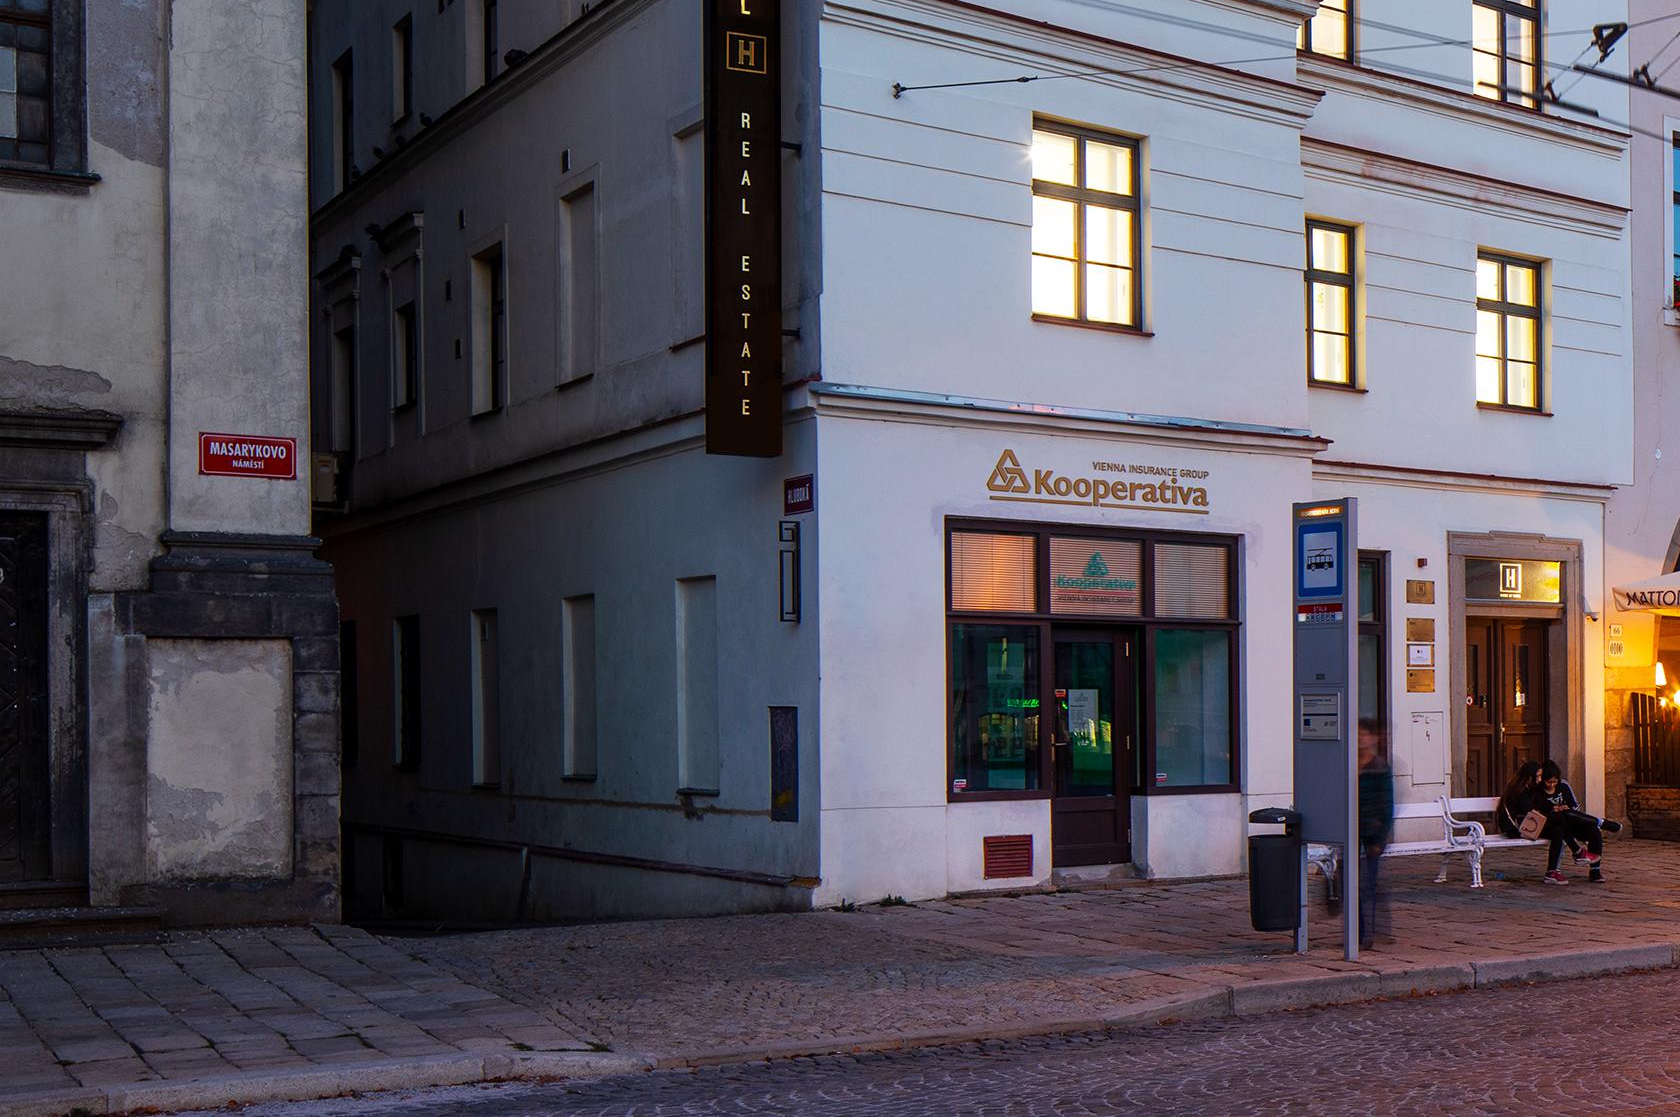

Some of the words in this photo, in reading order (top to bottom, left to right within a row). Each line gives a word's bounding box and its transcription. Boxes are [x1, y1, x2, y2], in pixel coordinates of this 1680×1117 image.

[740, 112, 751, 215] REAL
[740, 255, 751, 416] ESTATE
[209, 441, 287, 460] MASARYKOVO
[1092, 461, 1127, 474] VIENNA
[1128, 464, 1178, 478] INSURANCE
[1180, 468, 1210, 480] GROUP
[1034, 468, 1210, 508] Kooperativa
